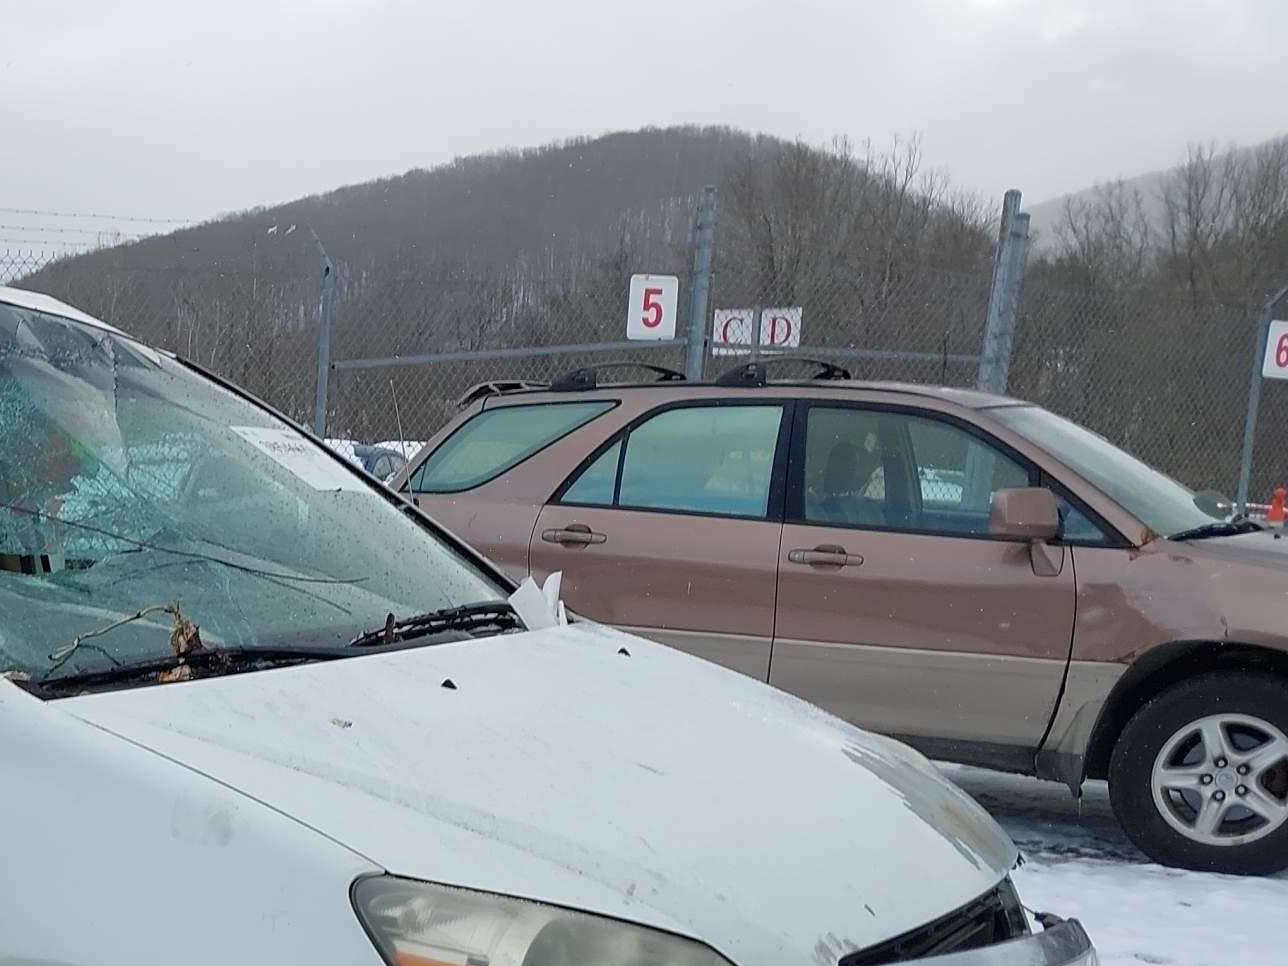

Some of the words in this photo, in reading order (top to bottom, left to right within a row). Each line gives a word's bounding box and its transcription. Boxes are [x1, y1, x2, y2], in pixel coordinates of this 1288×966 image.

[642, 288, 663, 328] 5
[722, 317, 744, 345] C
[769, 316, 792, 345] D
